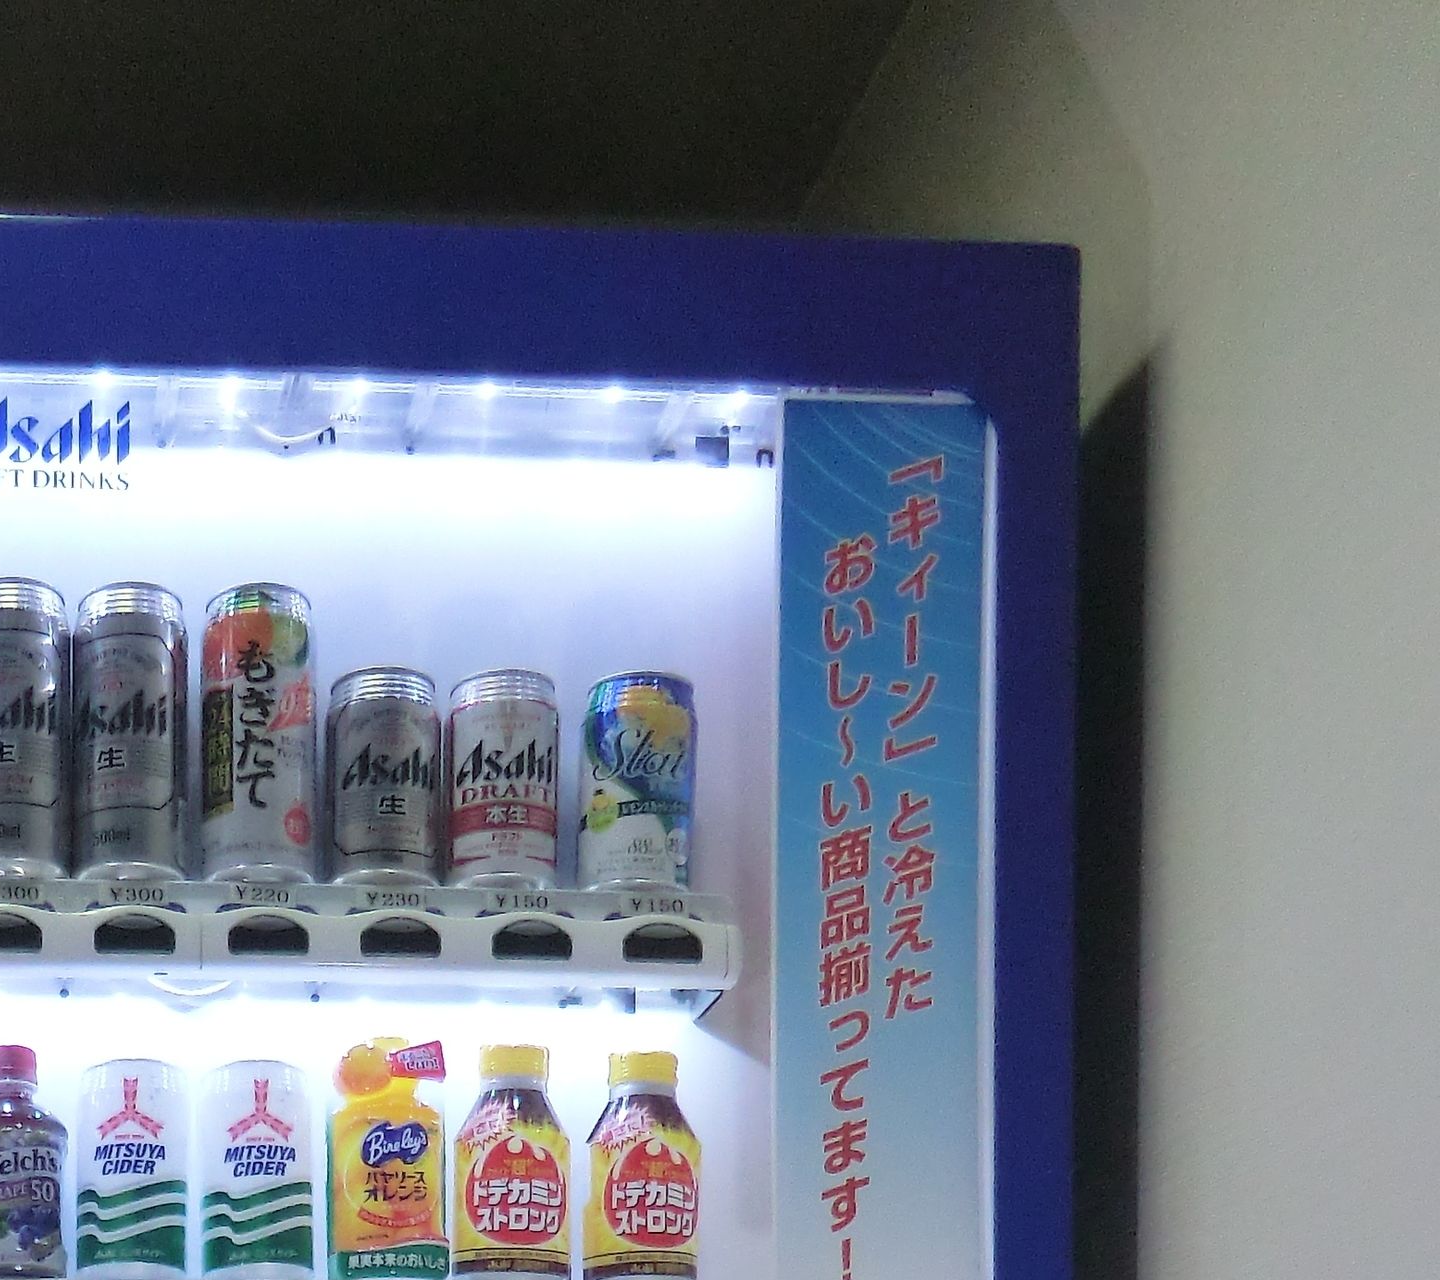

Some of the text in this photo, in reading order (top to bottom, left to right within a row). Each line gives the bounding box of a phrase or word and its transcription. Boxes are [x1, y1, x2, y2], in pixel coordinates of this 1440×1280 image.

[32, 469, 130, 492] DRINKS
[235, 639, 276, 808] もぎたて
[96, 746, 126, 770] 生
[342, 742, 438, 792] Asahi
[456, 738, 553, 787] Asahi
[377, 795, 407, 816] 生
[460, 785, 553, 806] DRAFT
[93, 1142, 166, 1162] MITSUYA
[223, 1143, 296, 1163] MITSUYA
[101, 1158, 156, 1176] CIDER
[232, 1160, 287, 1178] CIDER
[364, 1169, 426, 1186] バヤリース
[29, 1181, 57, 1203] 50
[363, 1185, 430, 1204] オレンジ
[472, 1178, 564, 1208] ドデカミン
[610, 1180, 697, 1210] ドデカミン
[476, 1206, 560, 1235] ストロング
[614, 1209, 695, 1238] ストロング
